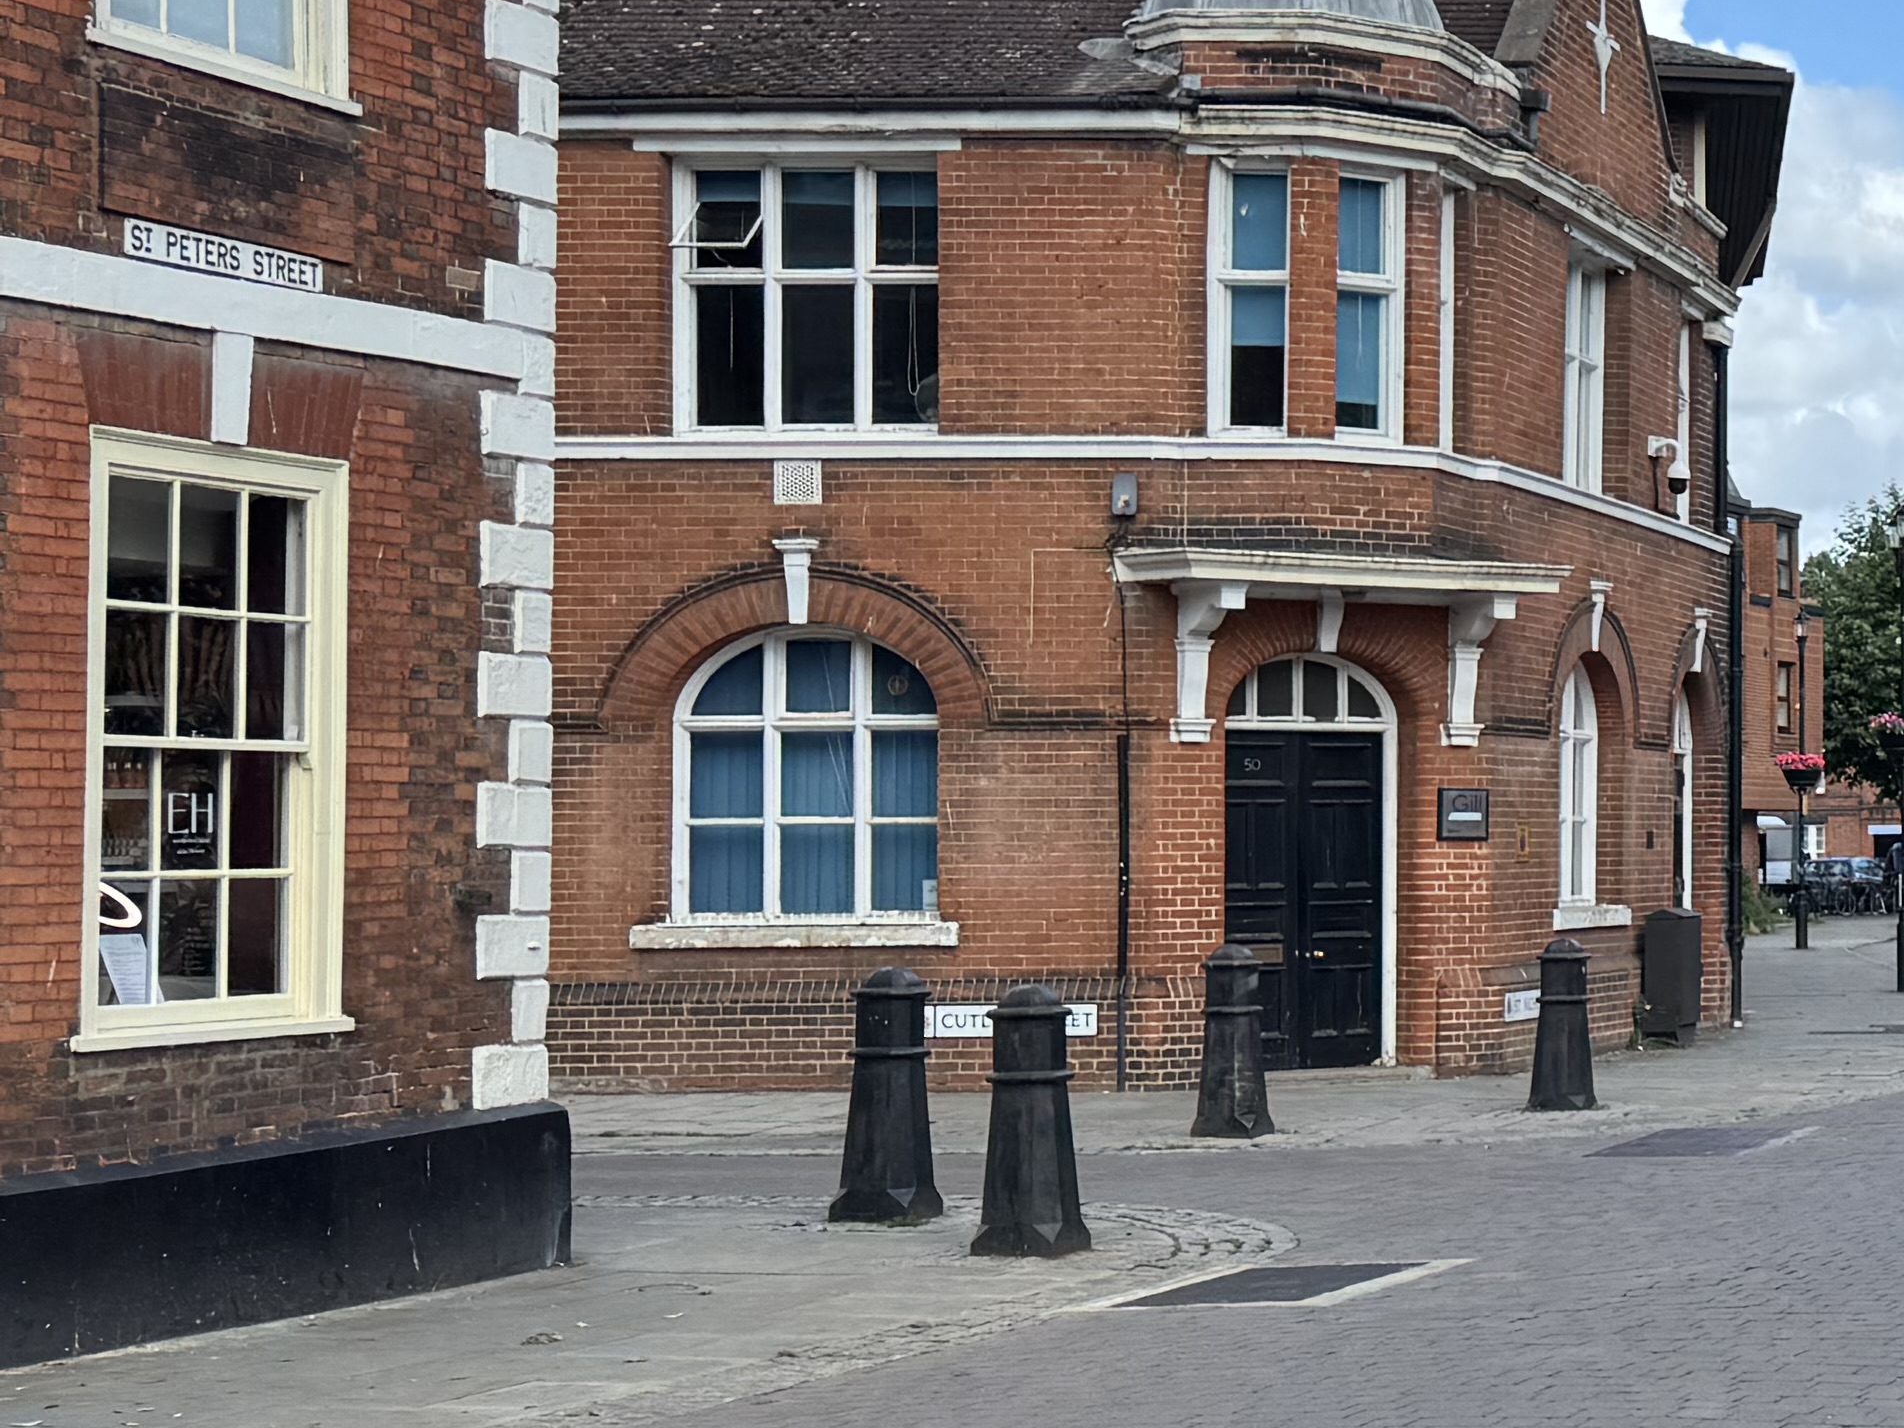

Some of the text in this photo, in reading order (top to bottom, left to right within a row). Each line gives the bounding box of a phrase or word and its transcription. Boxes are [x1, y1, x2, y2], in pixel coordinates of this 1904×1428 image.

[166, 231, 240, 272] PETERS
[253, 249, 319, 289] STREET
[1244, 758, 1261, 771] 50
[168, 793, 214, 834] EH
[1452, 794, 1483, 812] Gill
